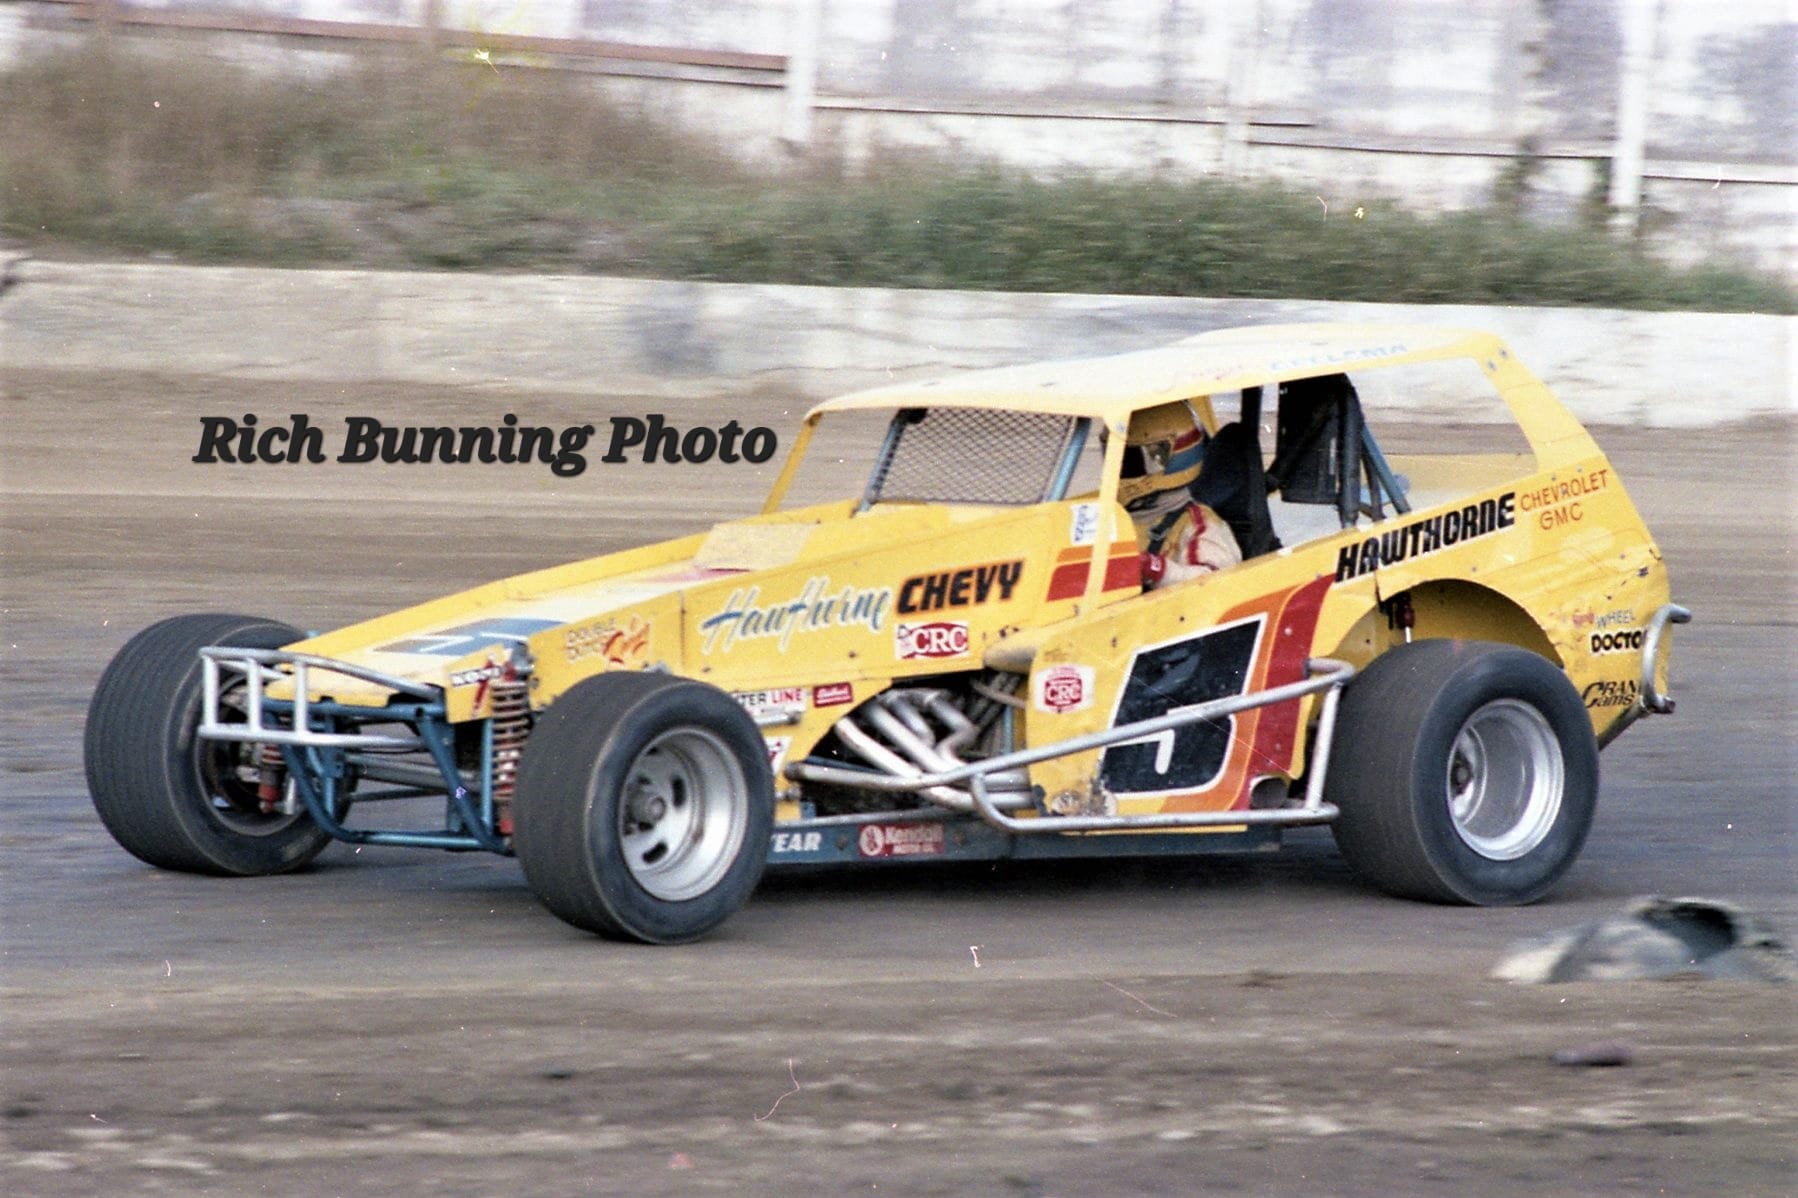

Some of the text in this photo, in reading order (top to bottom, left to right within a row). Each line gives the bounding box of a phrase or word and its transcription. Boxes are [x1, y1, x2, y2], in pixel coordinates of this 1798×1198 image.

[1521, 469, 1608, 512] CHEVROLET
[1539, 502, 1583, 531] GMC
[1335, 492, 1515, 582] HAWTHORNE
[897, 562, 1023, 615] CHEVY
[912, 627, 967, 654] CRC
[770, 687, 803, 704] LINE
[1582, 680, 1642, 700] CRAN
